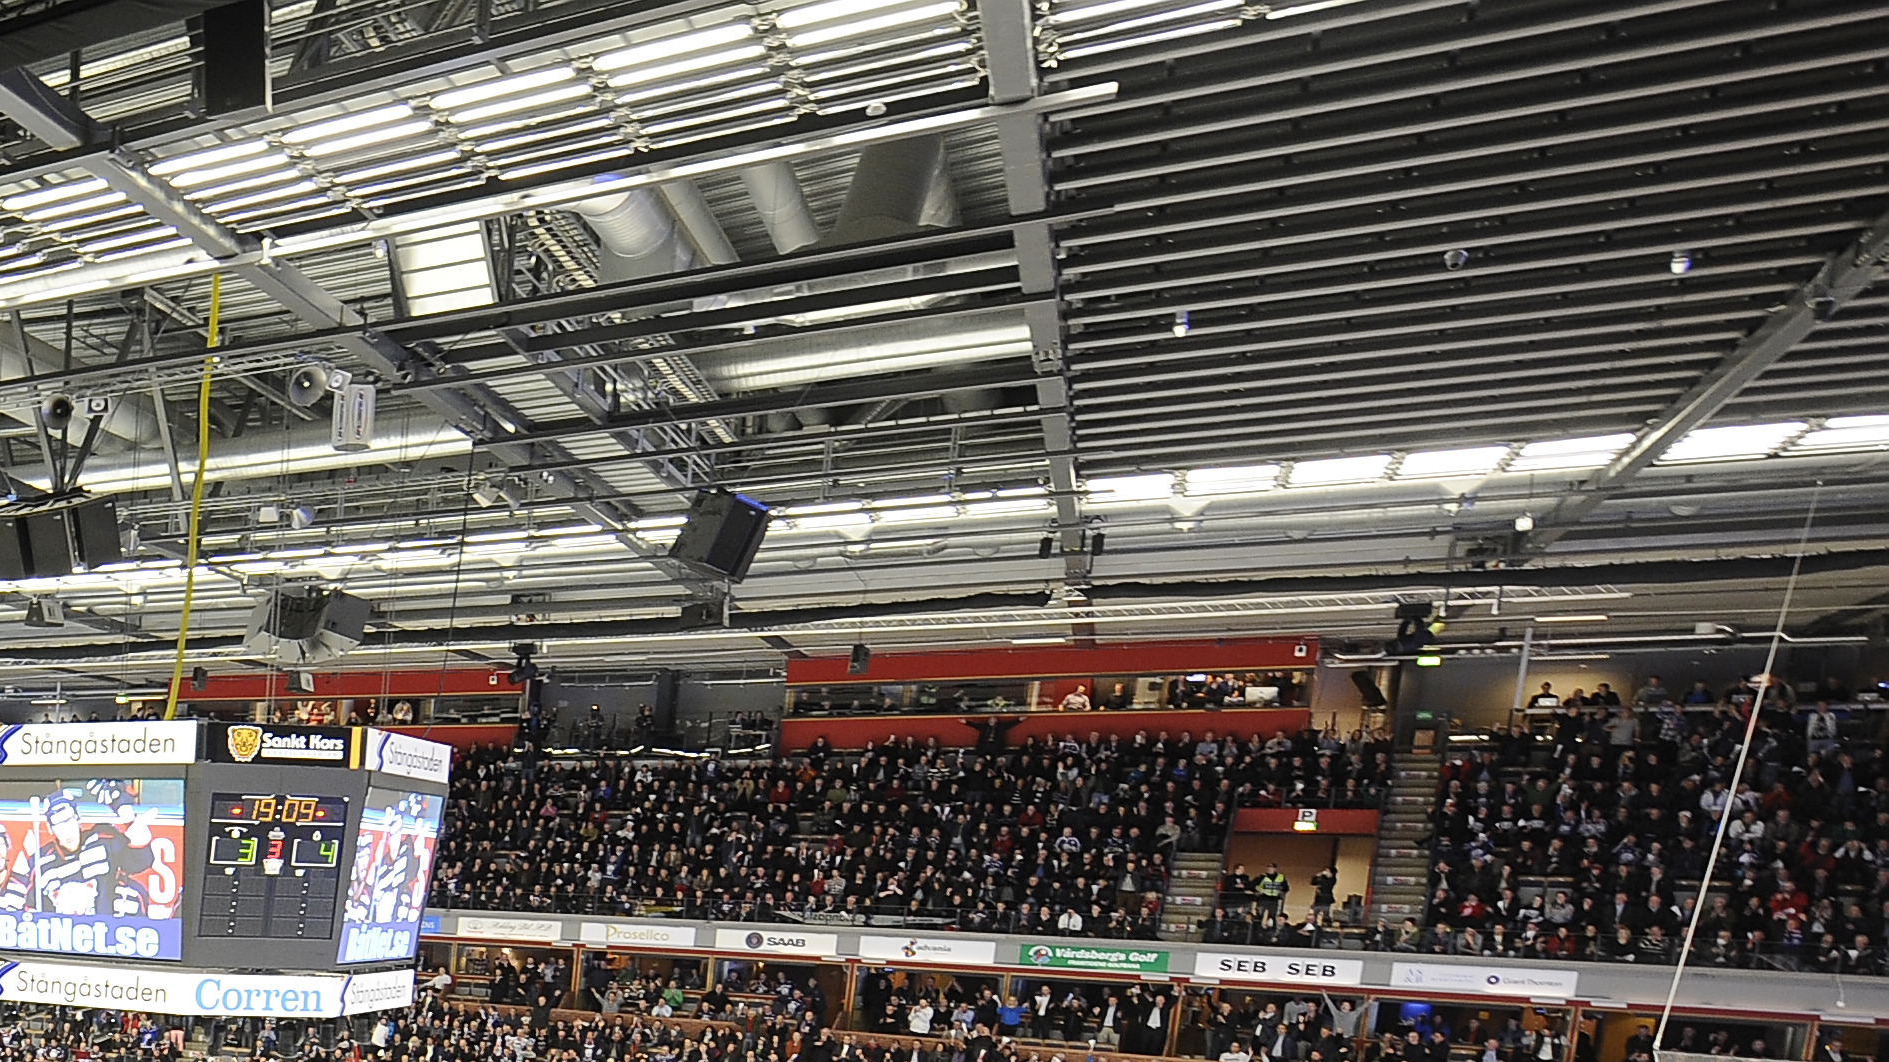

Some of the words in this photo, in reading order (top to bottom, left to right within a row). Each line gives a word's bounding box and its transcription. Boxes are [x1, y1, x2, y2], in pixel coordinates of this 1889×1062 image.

[20, 727, 176, 761] Stångåstaden
[261, 731, 308, 750] Sankt
[308, 733, 344, 751] Kors
[388, 740, 443, 775] Stångåstaden
[251, 799, 317, 823] 19:09
[1300, 810, 1315, 822] P
[237, 839, 255, 862] 3
[266, 840, 283, 859] 3
[319, 842, 336, 863] 4
[345, 925, 410, 961] BåtNet.se
[605, 924, 670, 942] Prosellco
[766, 936, 806, 948] SAAB
[915, 944, 952, 953] advania
[1055, 947, 1127, 962] Vårdsbergs
[1128, 951, 1160, 963] Golf
[1219, 958, 1267, 973] SEB
[1287, 962, 1336, 977] SEB
[17, 970, 167, 1002] Stångåstaden
[195, 978, 323, 1012] Corren
